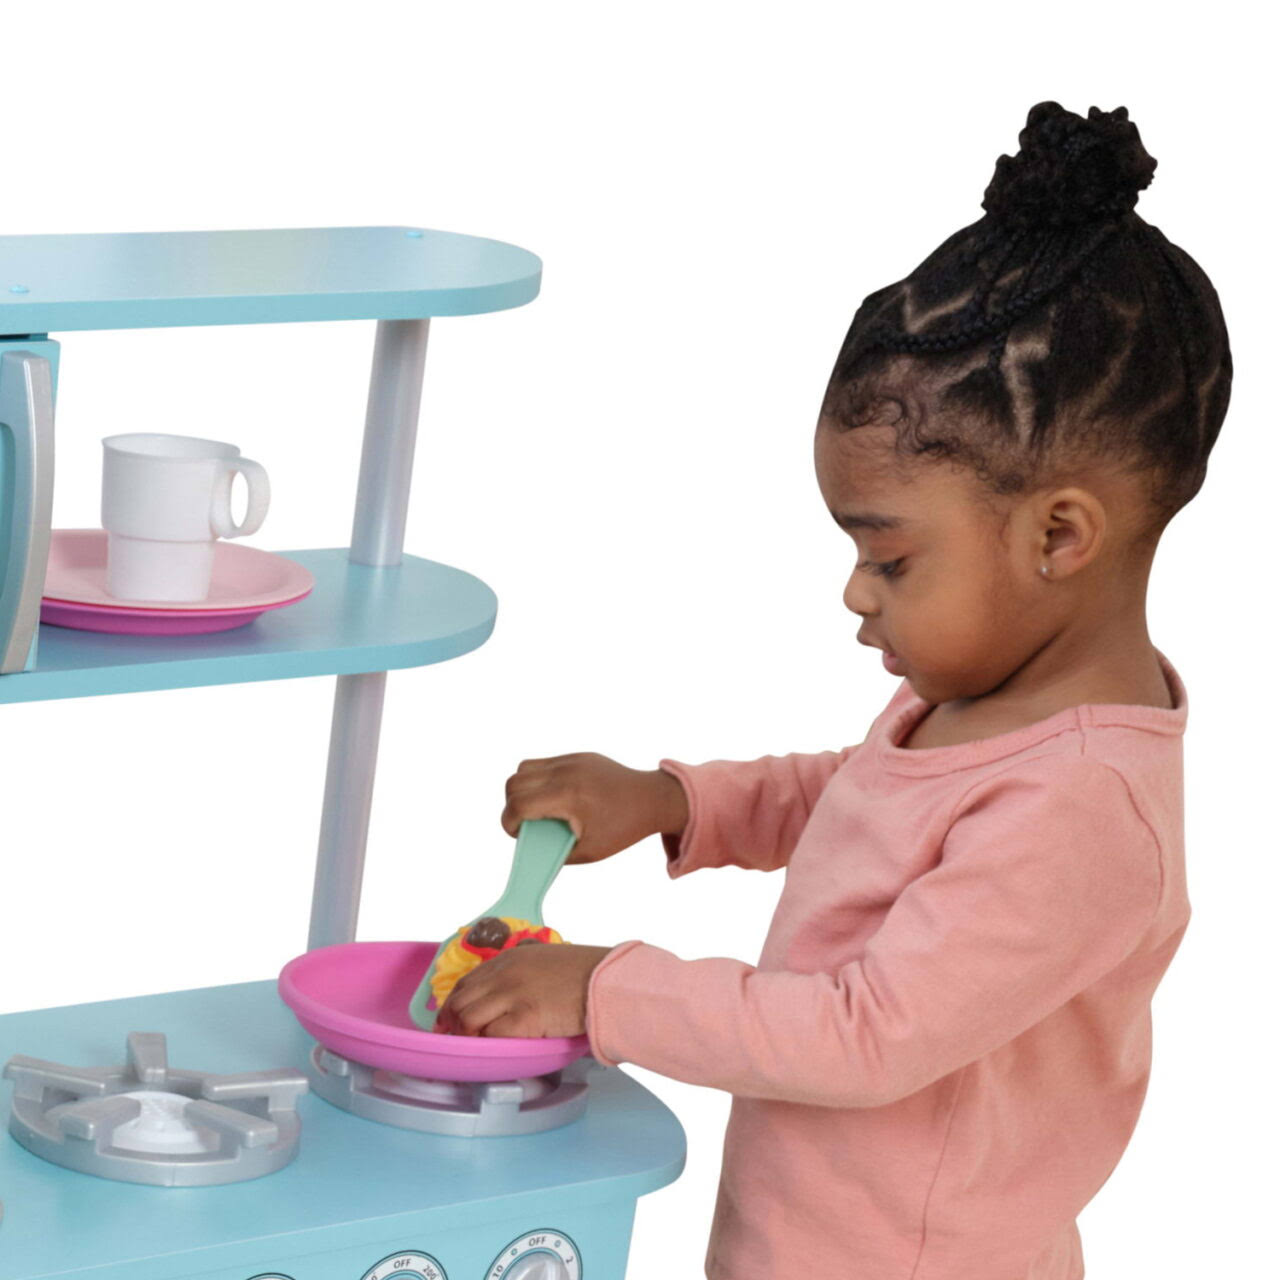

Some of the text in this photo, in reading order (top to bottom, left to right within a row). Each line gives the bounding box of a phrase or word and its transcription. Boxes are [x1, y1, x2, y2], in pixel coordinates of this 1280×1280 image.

[393, 1259, 411, 1269] OFF
[492, 1265, 503, 1278] 10
[529, 1236, 546, 1247] OFF
[566, 1256, 574, 1264] 2
